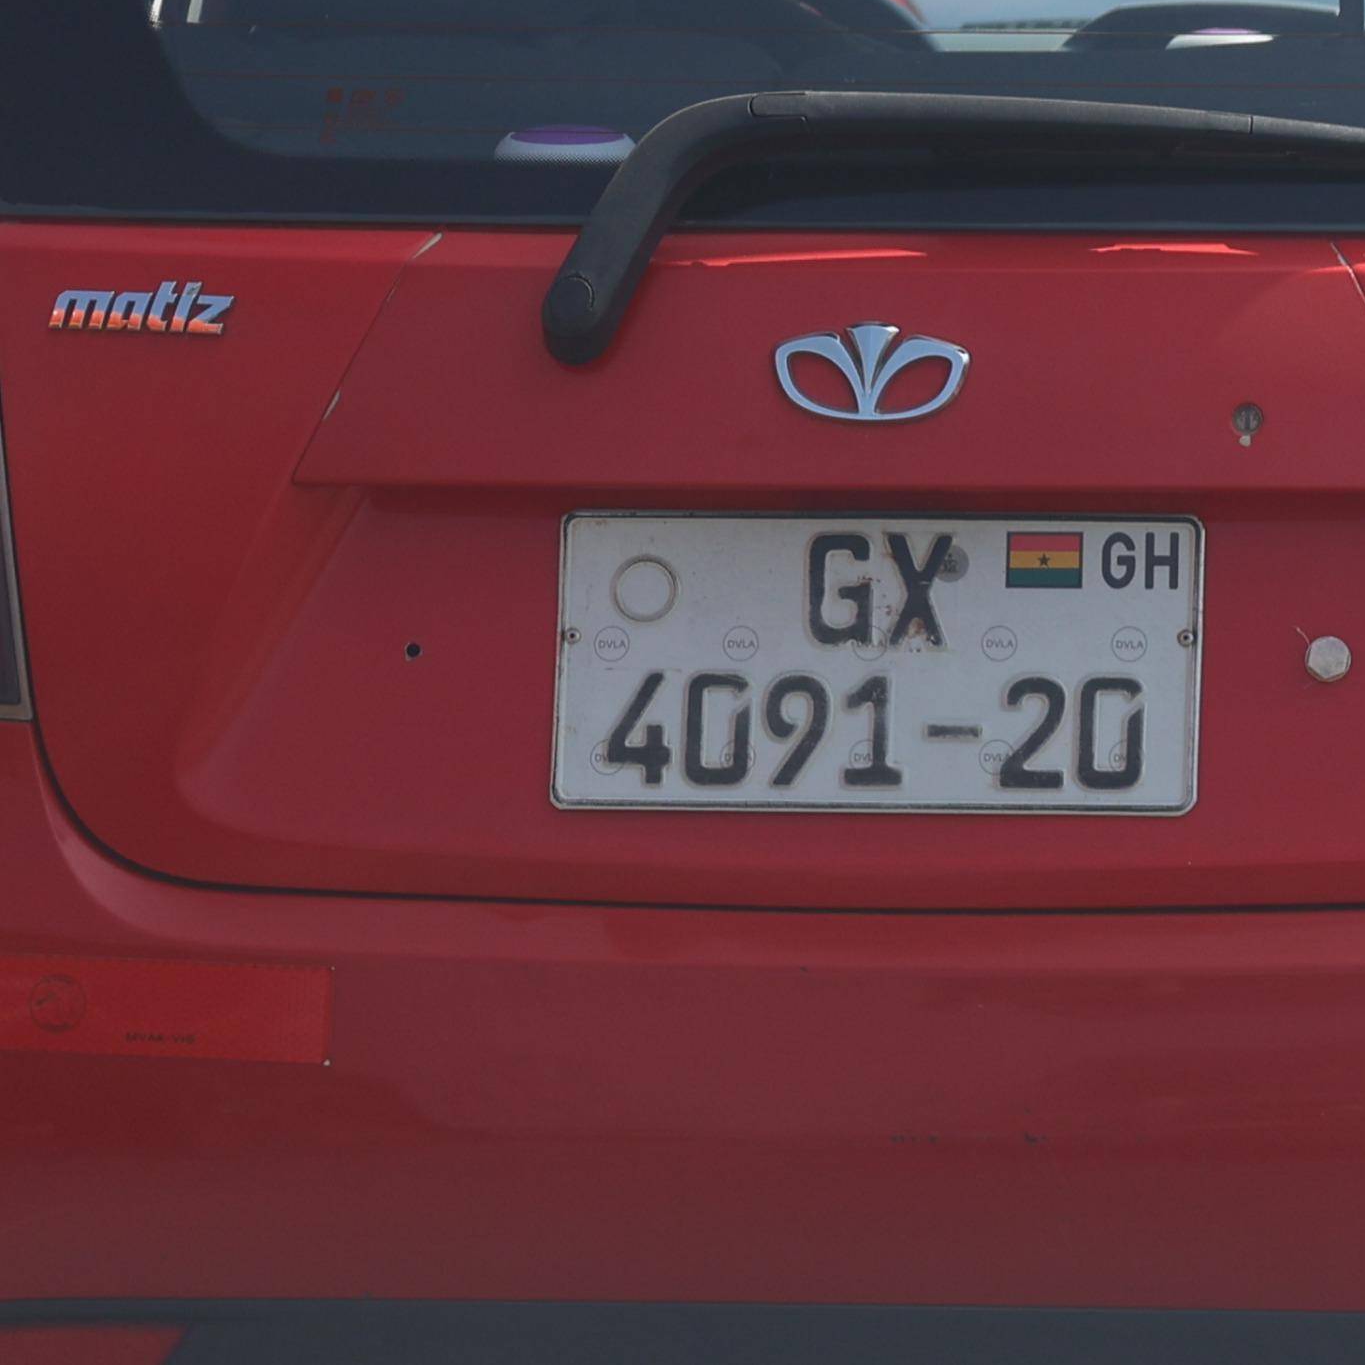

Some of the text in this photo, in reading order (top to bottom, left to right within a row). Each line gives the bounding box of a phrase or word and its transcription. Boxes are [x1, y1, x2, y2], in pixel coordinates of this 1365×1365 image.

[48, 281, 234, 335] matiz
[1101, 531, 1180, 590] GH
[807, 533, 953, 647] GX
[598, 639, 626, 649] DVLA
[727, 639, 755, 649] DVLA
[986, 639, 1014, 649] DVLA
[1115, 639, 1144, 650] DVLA
[606, 672, 1144, 790] 4091-20
